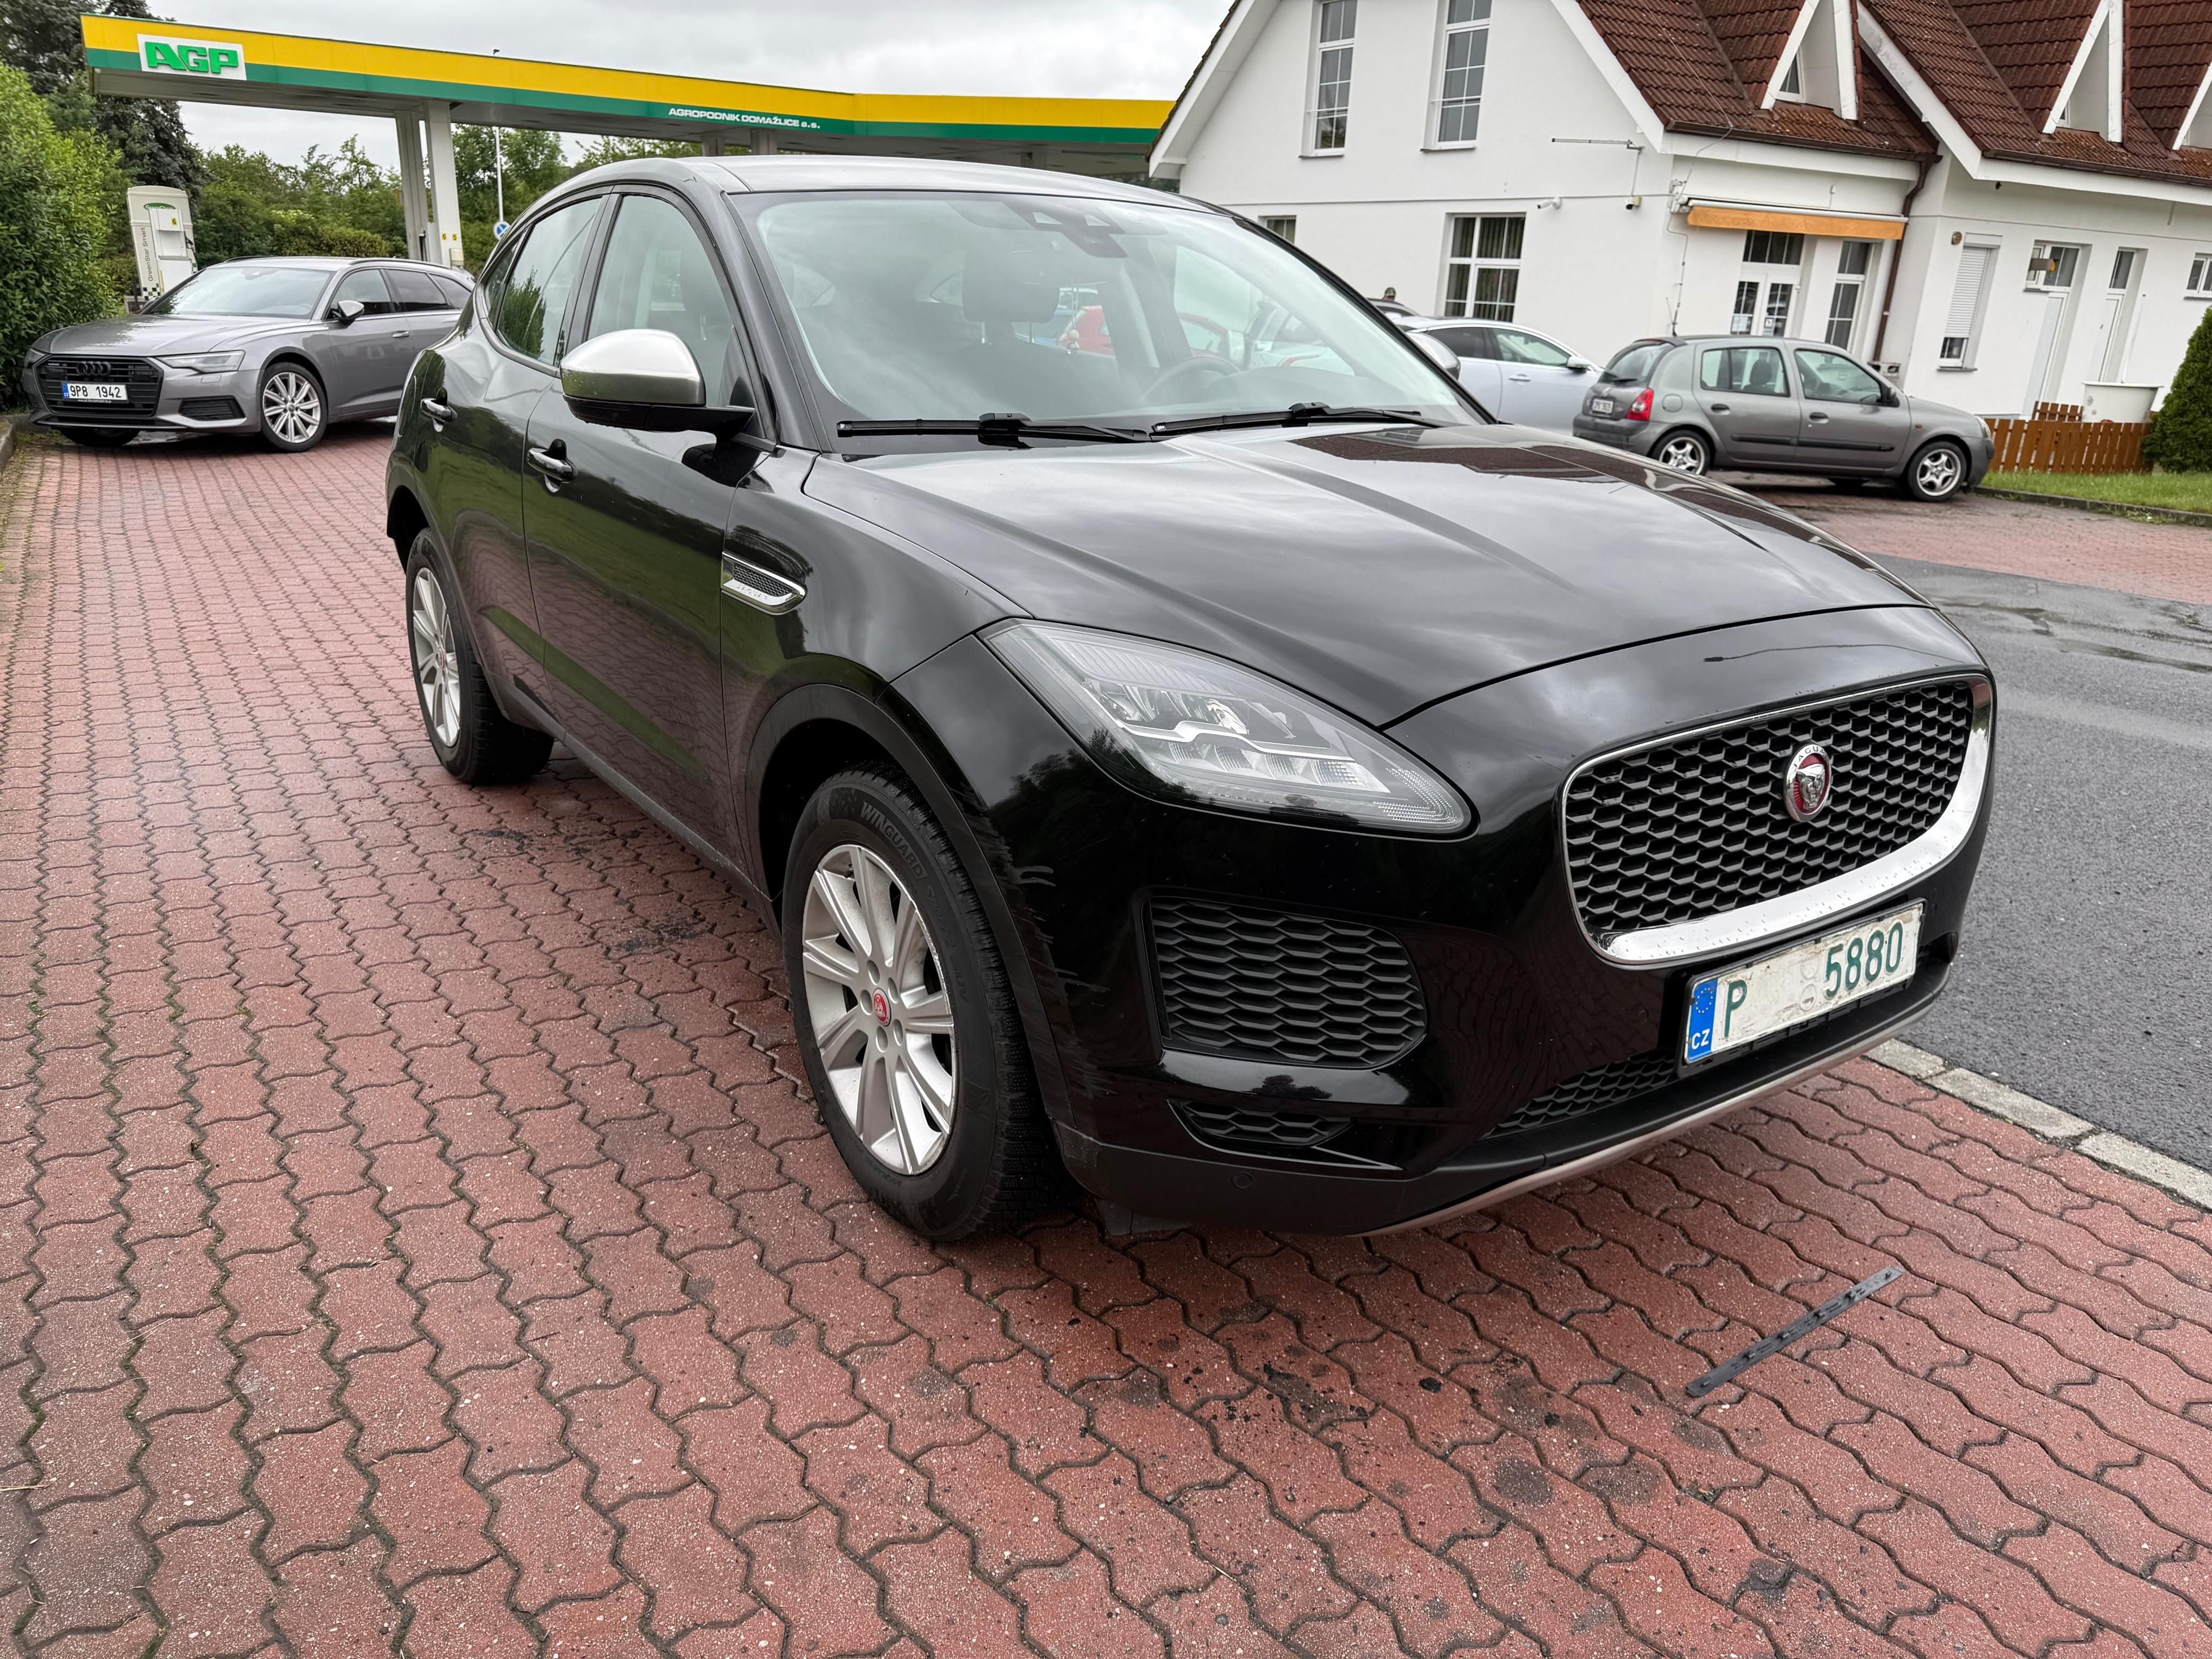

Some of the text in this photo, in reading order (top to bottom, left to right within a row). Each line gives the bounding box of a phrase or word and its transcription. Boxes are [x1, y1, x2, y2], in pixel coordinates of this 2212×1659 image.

[145, 41, 239, 74] AGP
[669, 108, 740, 122] AGROPODNIK
[741, 115, 799, 127] DOMAŽLICE
[145, 248, 153, 281] GreenStar
[70, 386, 122, 398] 9P8 1942
[860, 801, 924, 880] WINGUARD
[1724, 922, 1904, 1037] P 5880
[1691, 1028, 1710, 1049] CZ
